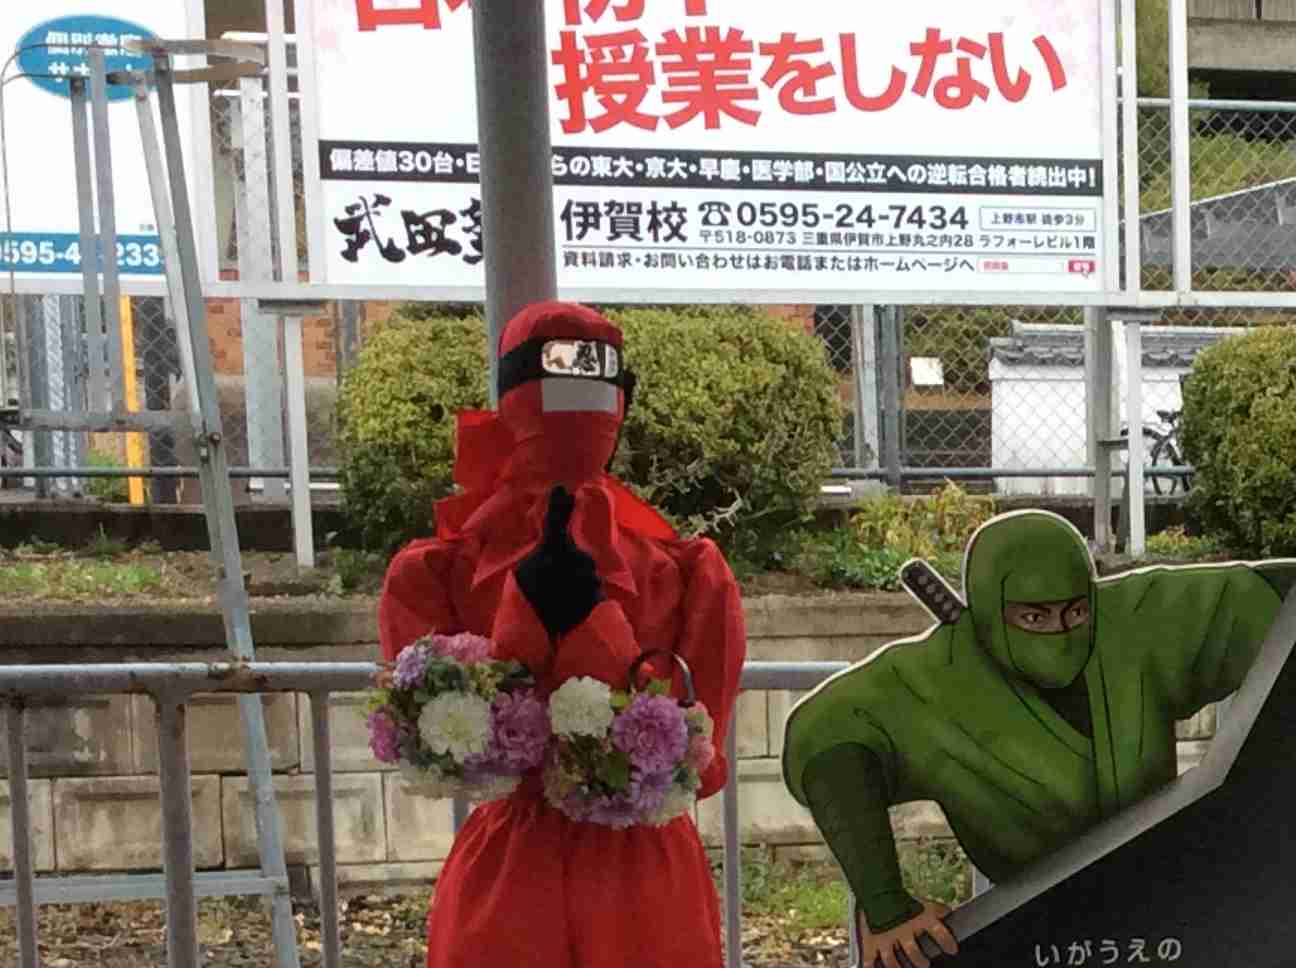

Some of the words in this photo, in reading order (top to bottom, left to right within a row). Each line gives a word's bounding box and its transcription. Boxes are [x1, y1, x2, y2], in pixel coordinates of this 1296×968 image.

[551, 26, 1068, 134] 授業をしない
[560, 199, 688, 243] 伊賀校
[737, 201, 969, 230] 0595-24-7434
[1034, 937, 1182, 967] いがうえの
